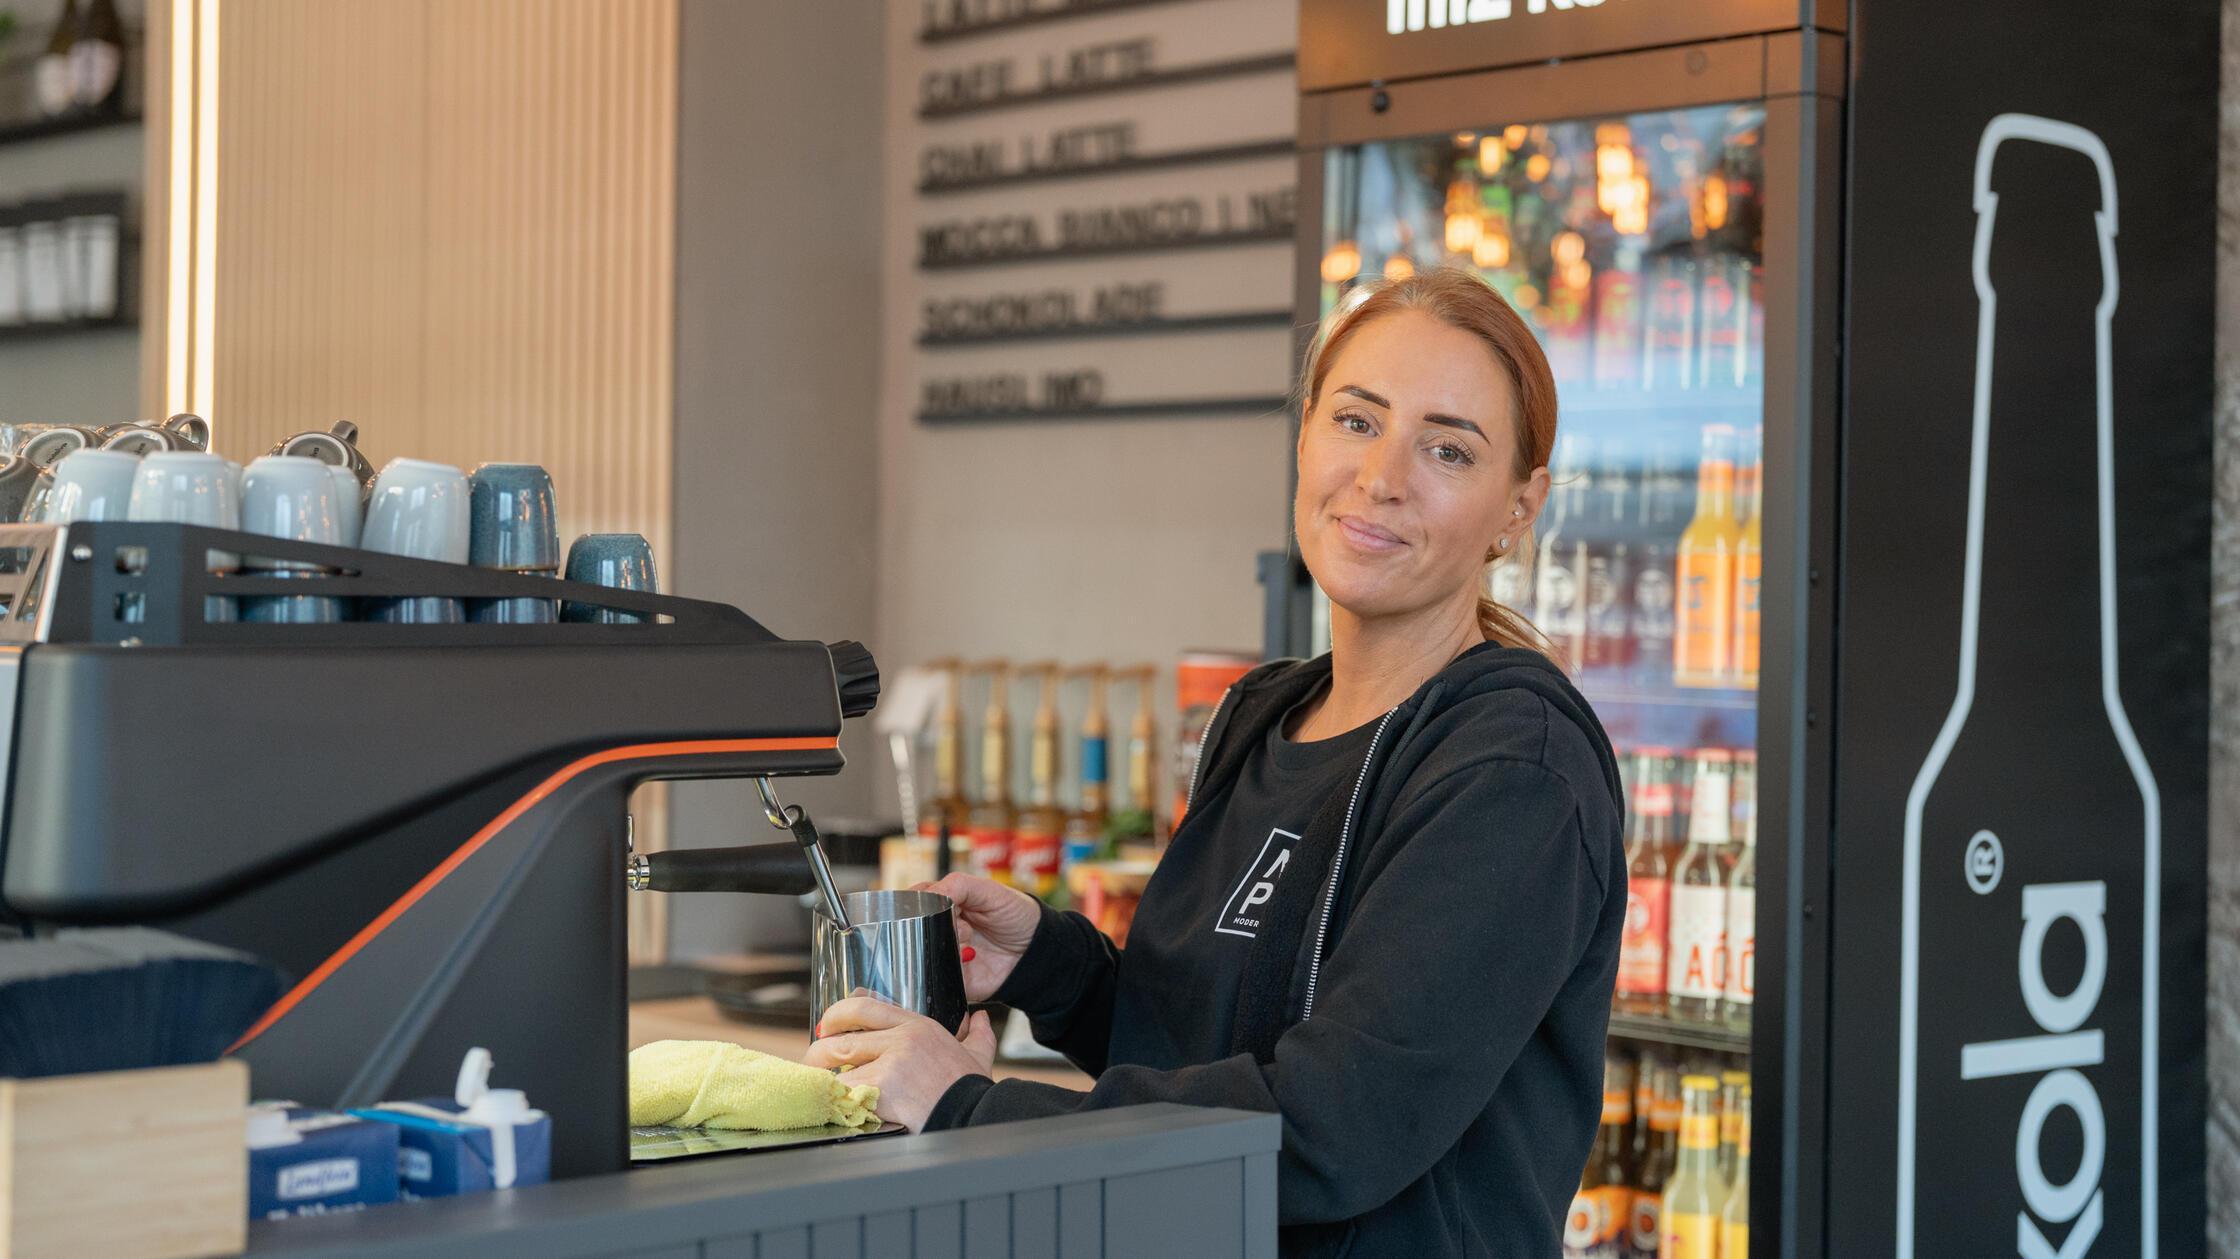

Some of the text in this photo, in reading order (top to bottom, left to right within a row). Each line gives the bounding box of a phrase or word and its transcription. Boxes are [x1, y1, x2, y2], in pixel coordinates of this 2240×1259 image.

[1038, 38, 1154, 88] LATTE
[1019, 121, 1136, 171] LATTE
[922, 212, 1040, 257] MOCCA
